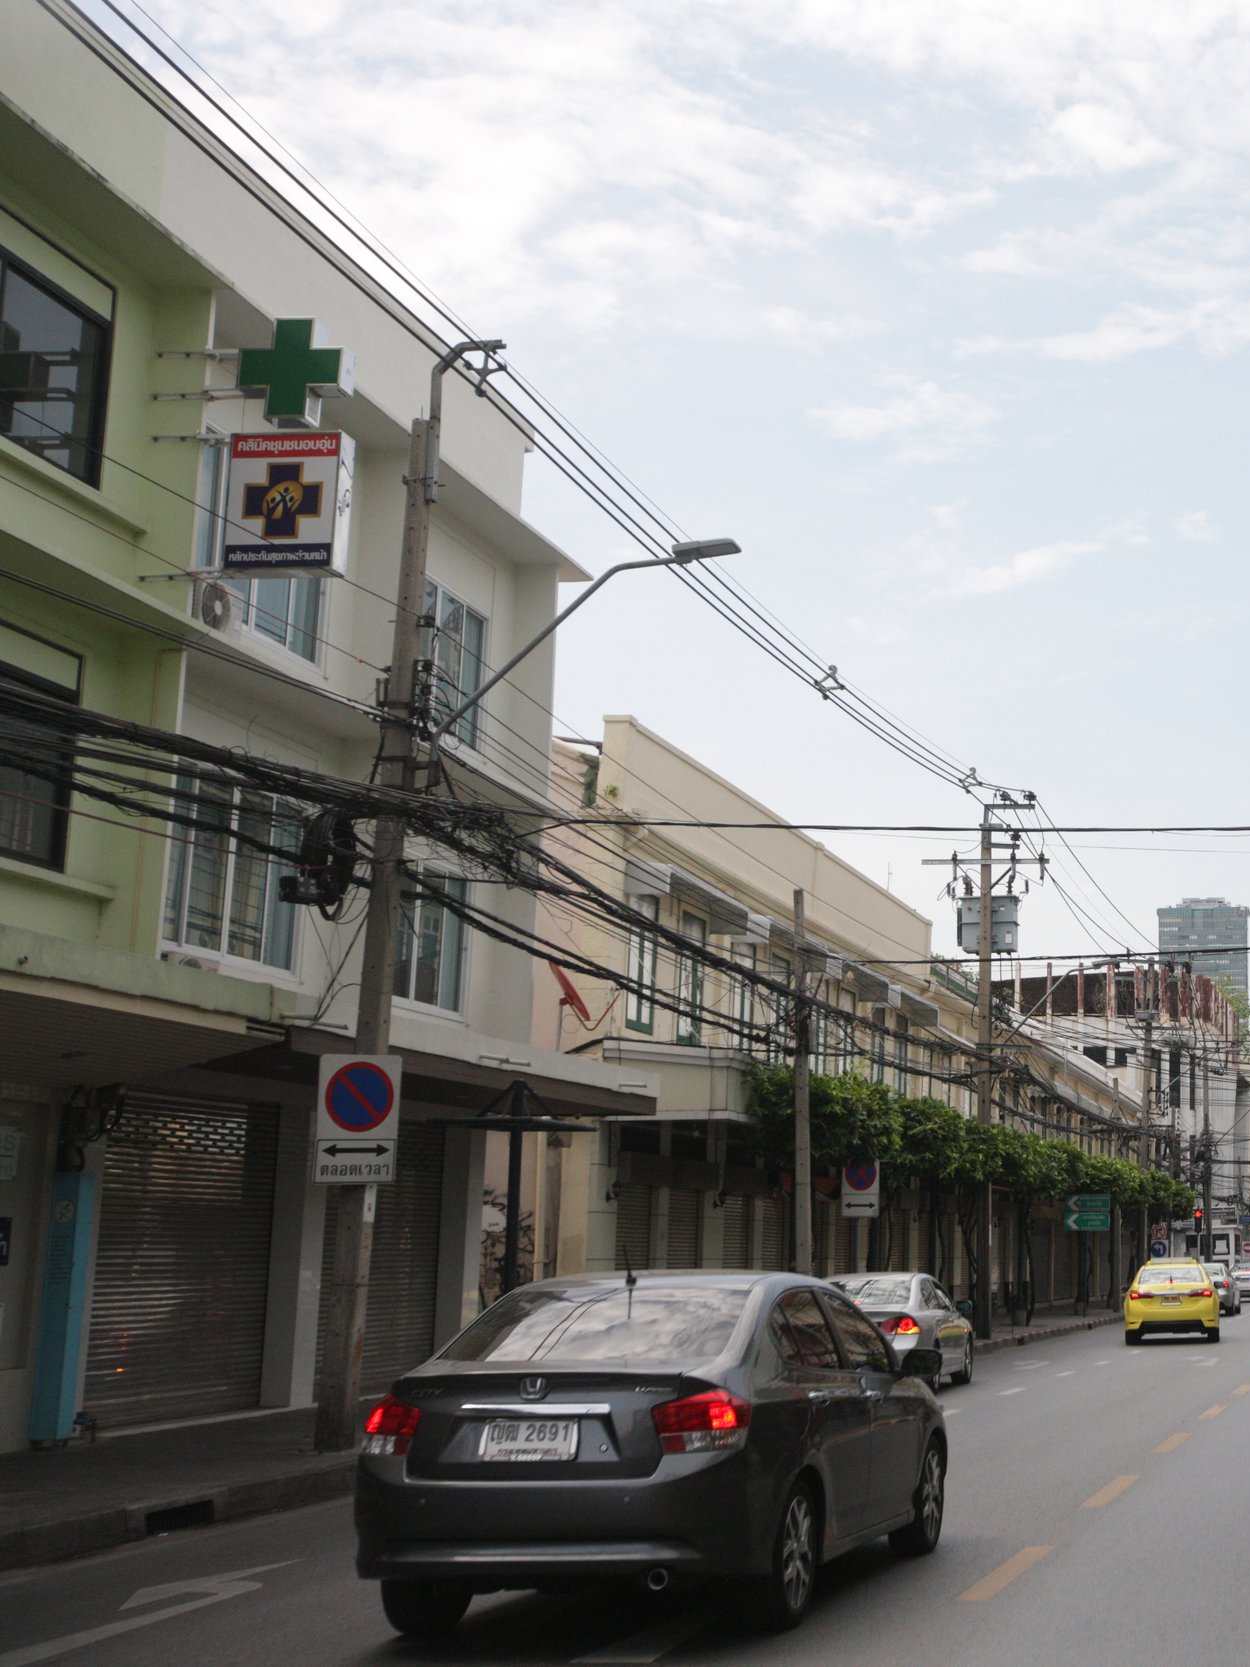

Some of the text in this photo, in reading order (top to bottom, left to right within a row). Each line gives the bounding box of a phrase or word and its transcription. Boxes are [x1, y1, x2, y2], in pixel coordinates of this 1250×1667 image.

[320, 1163, 390, 1177] ตลอดเวลา
[524, 1422, 570, 1443] 2691
